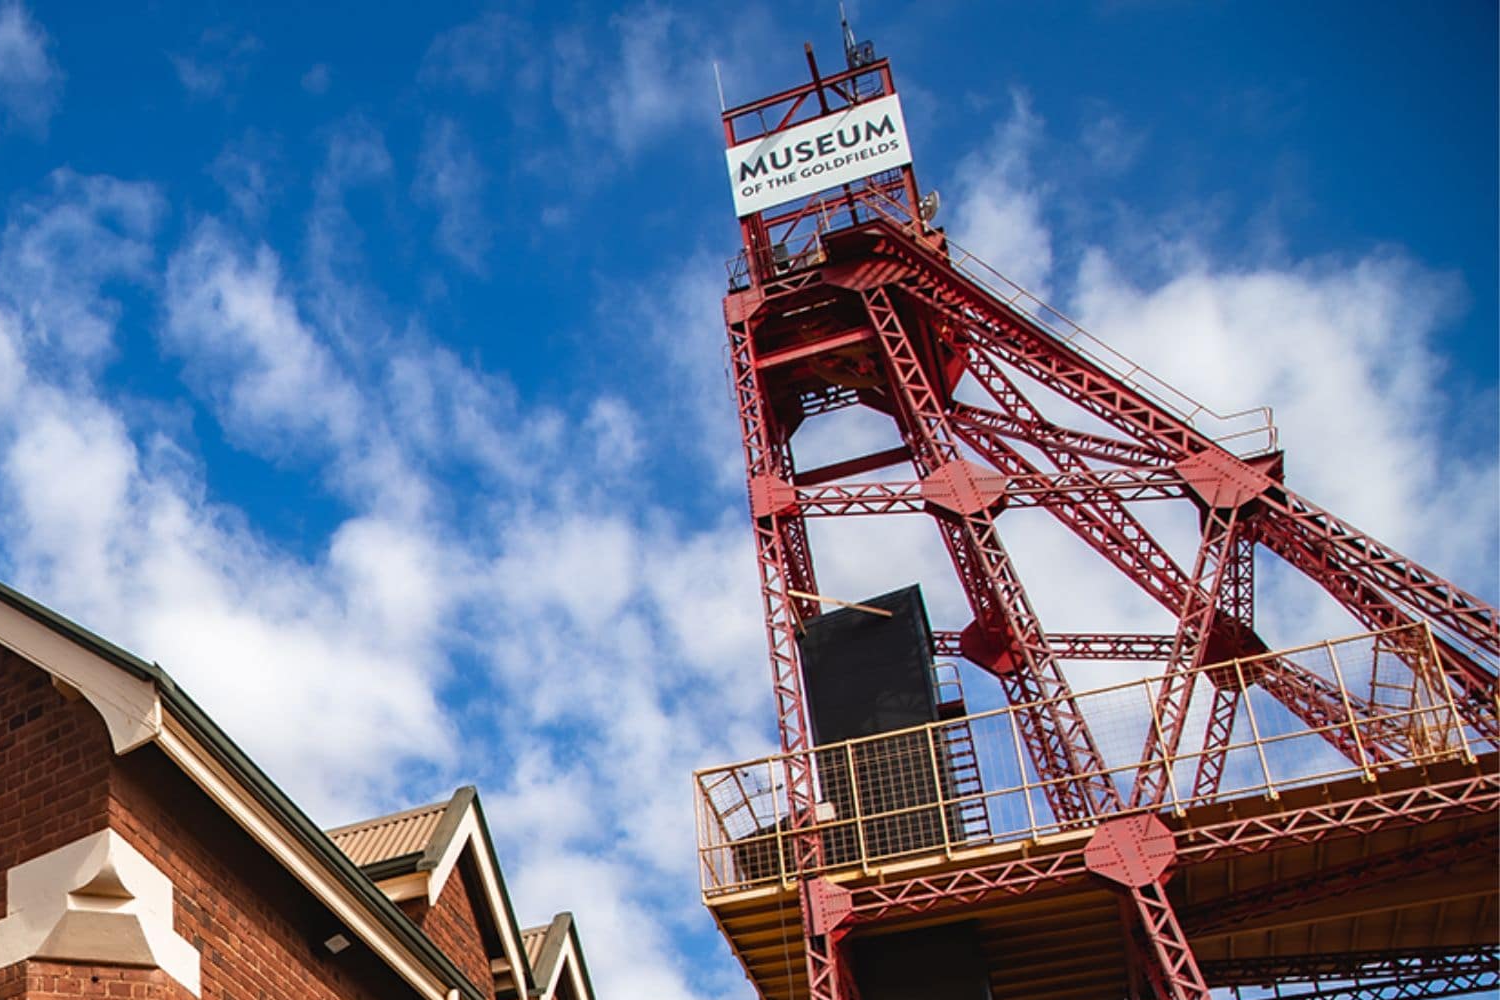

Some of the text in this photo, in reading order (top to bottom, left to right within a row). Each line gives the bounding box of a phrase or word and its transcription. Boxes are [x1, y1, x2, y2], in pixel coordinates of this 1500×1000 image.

[739, 113, 896, 182] MUSEUM
[741, 139, 900, 198] OF THE GOLDFIELDS
